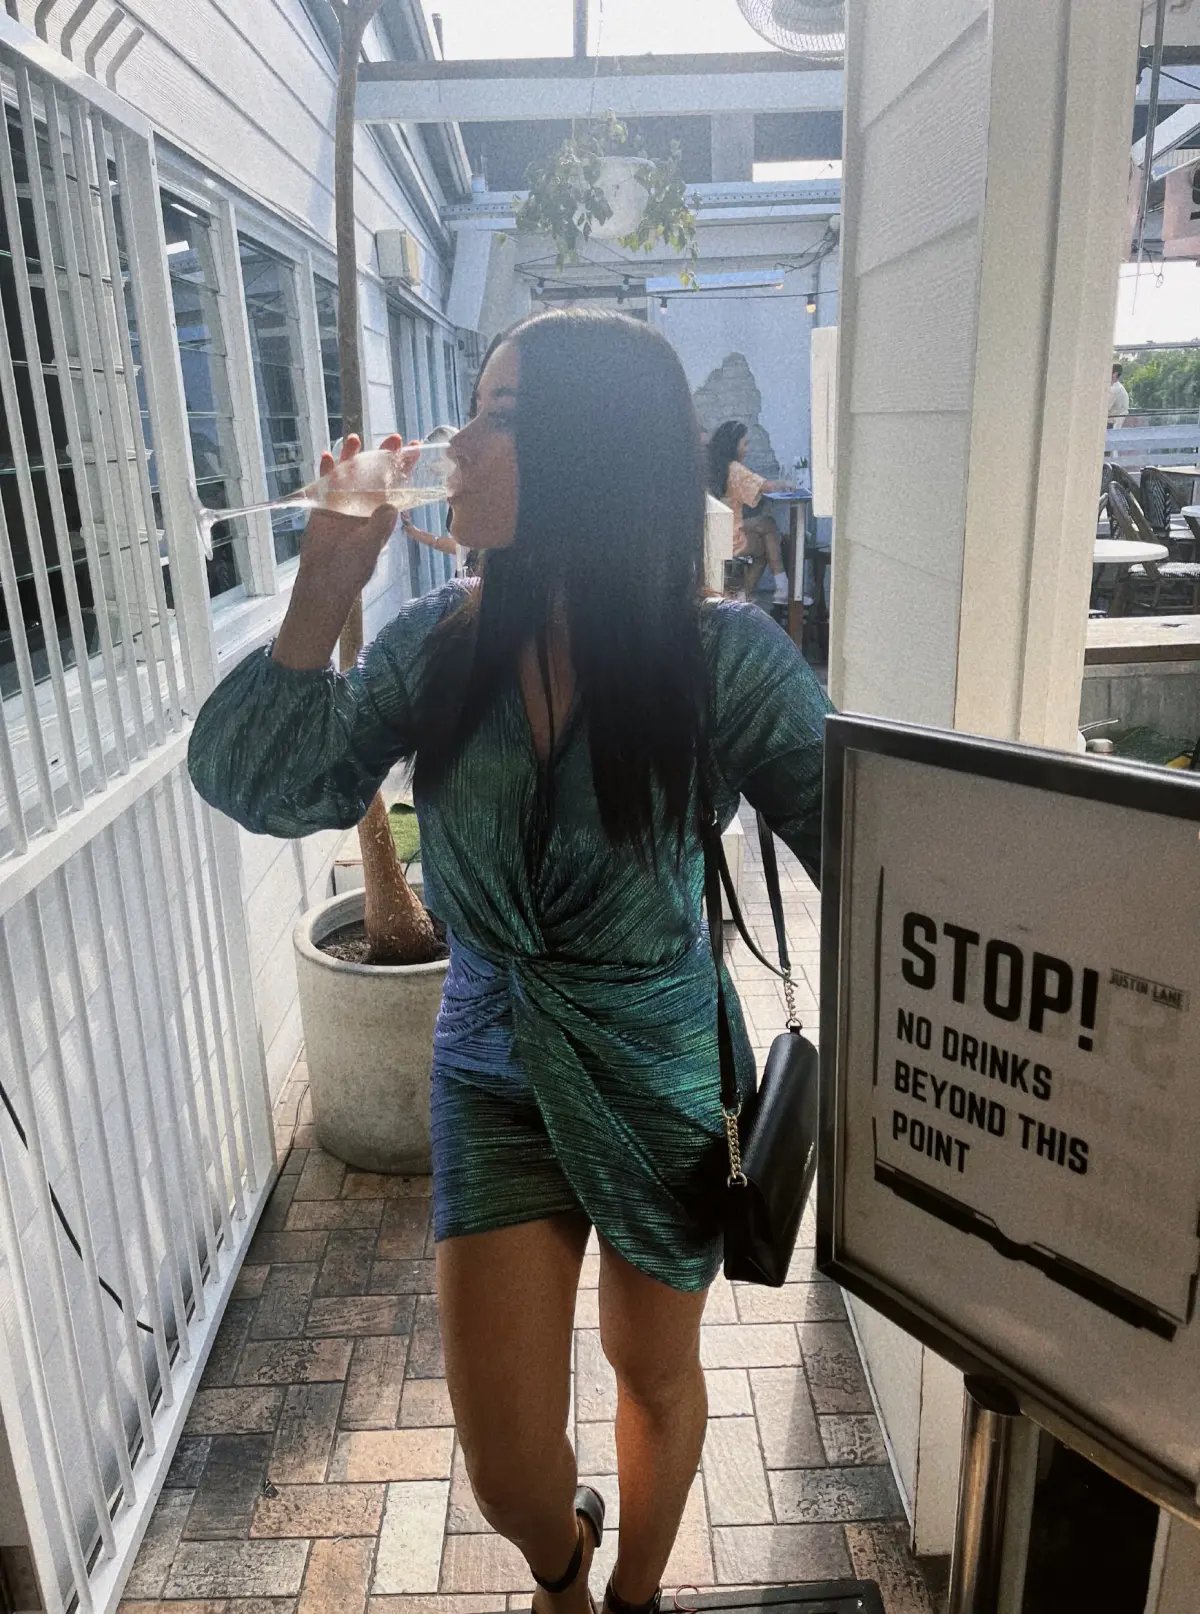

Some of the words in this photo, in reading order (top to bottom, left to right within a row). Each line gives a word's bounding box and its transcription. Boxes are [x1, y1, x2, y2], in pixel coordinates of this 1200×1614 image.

[901, 911, 1100, 1052] STOP!
[1109, 971, 1149, 995] JUSTIN
[1152, 985, 1185, 1007] LANE
[896, 1007, 933, 1051] NO
[941, 1025, 1053, 1102] DRINKS
[891, 1109, 971, 1174] POINT
[893, 1058, 1007, 1139] BEYOND
[1017, 1112, 1090, 1176] THIS
